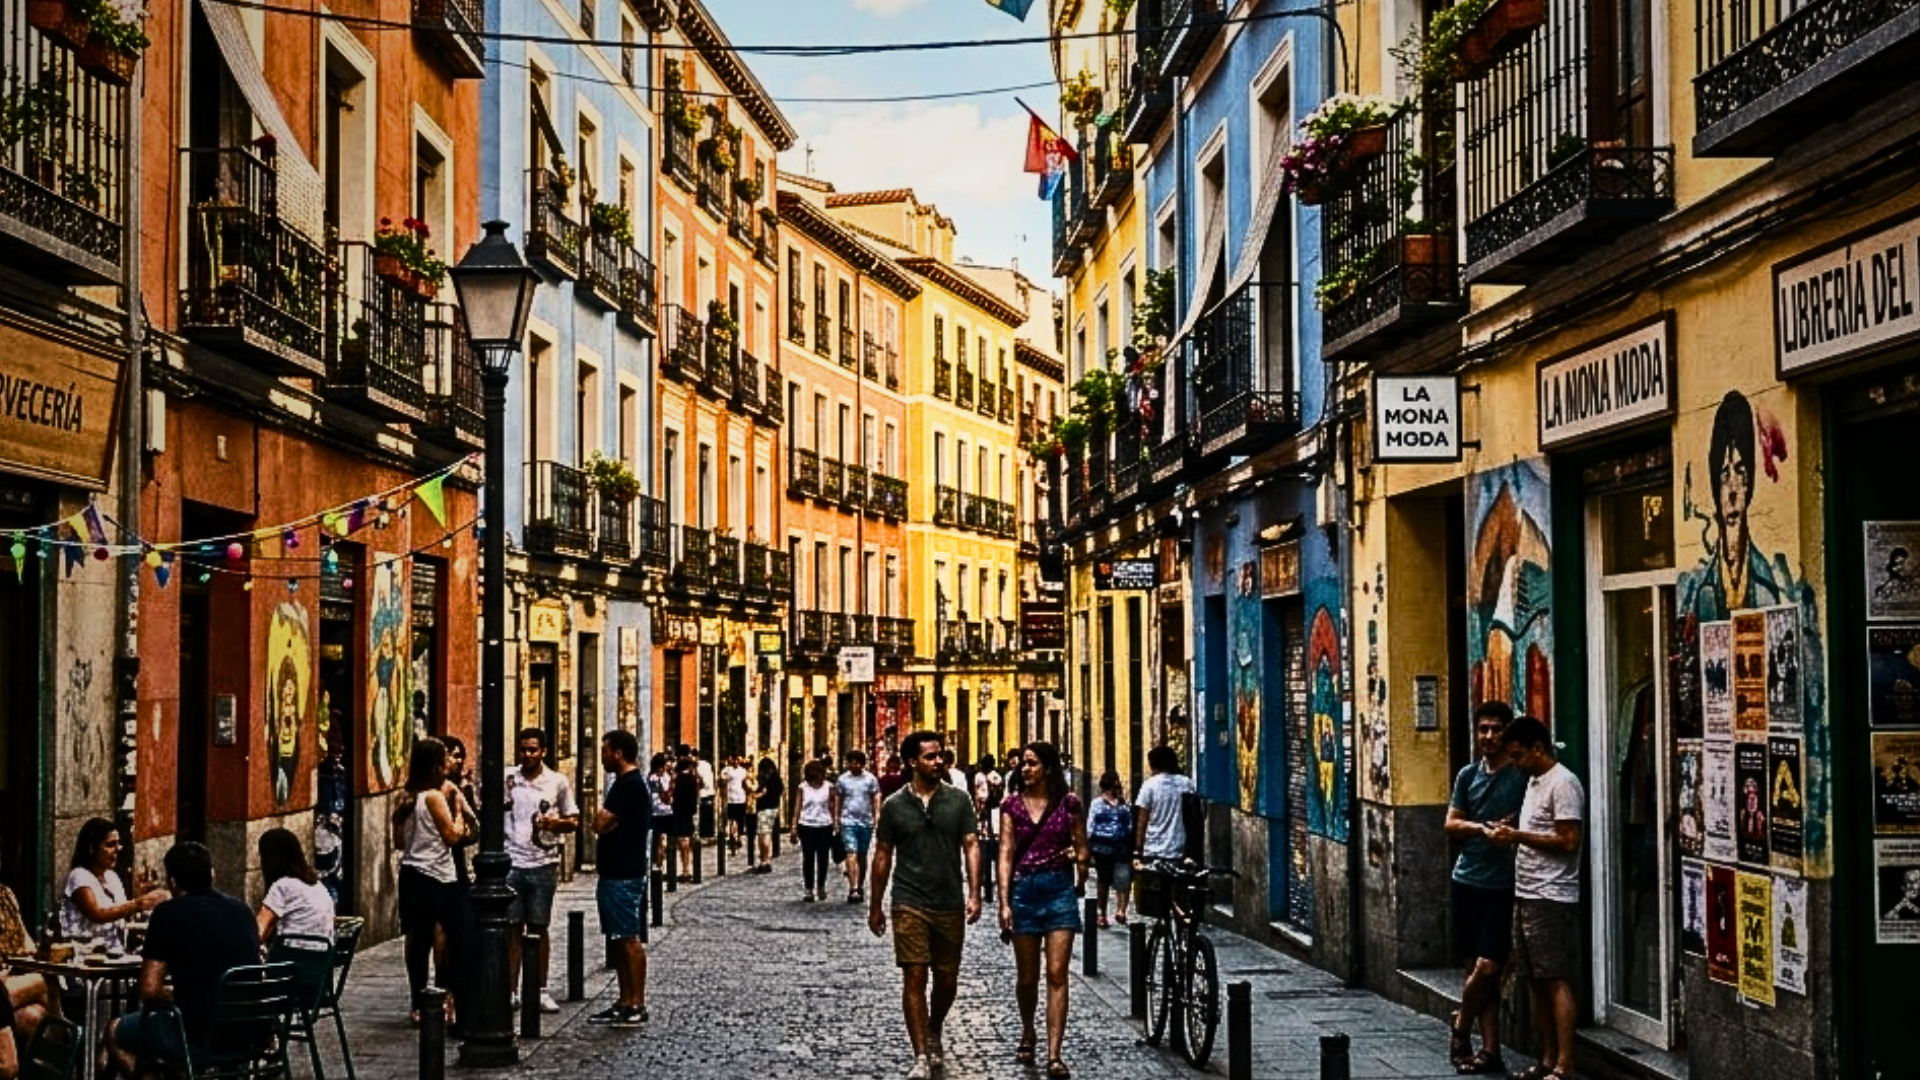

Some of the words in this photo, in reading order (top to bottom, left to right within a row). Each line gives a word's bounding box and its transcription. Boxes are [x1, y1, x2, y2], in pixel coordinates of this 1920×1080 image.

[1782, 245, 1868, 353] LIBRERÍA
[1871, 243, 1913, 326] DEL
[1543, 376, 1562, 430] LA
[1565, 358, 1611, 424] MONA
[1614, 338, 1664, 410] MODA
[1403, 386, 1431, 402] LA
[1385, 408, 1449, 424] MONA
[1386, 431, 1449, 447] MODA
